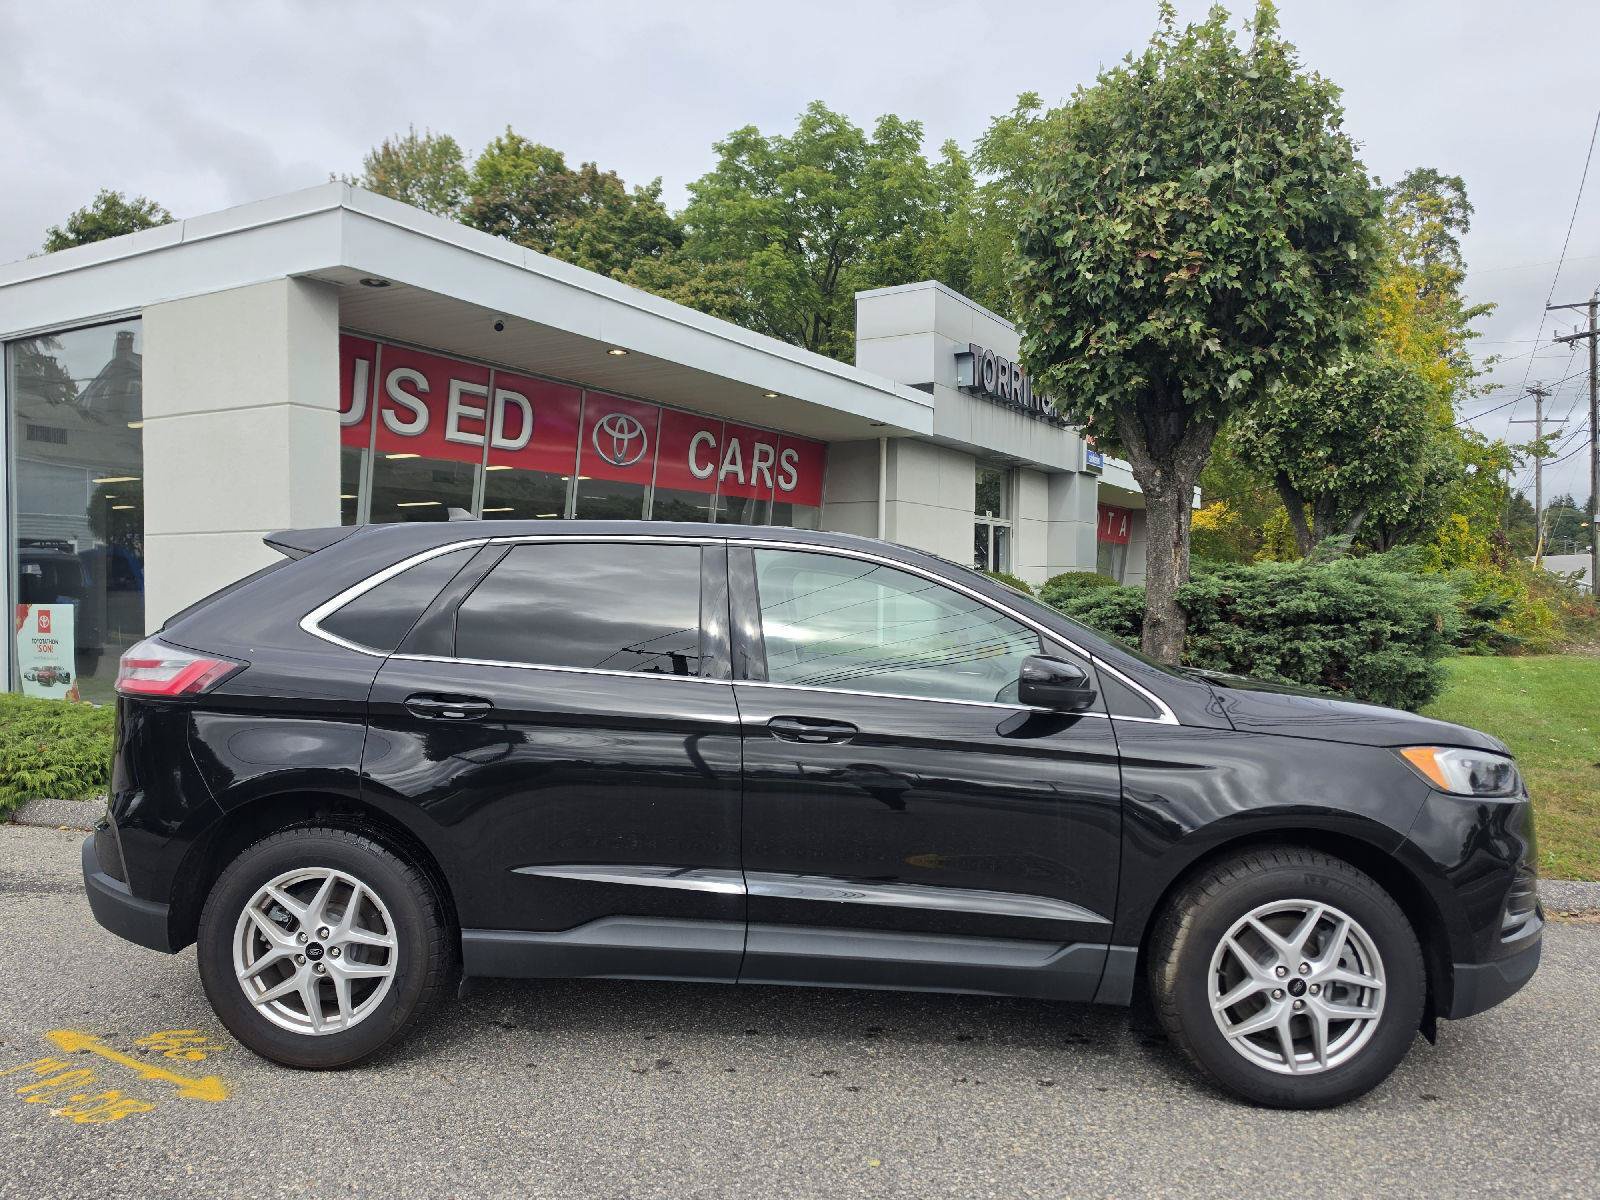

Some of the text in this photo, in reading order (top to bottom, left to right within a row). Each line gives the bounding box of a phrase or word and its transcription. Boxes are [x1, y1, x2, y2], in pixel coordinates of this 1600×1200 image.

[340, 358, 799, 492] USED CARS
[969, 343, 1057, 416] TORRI
